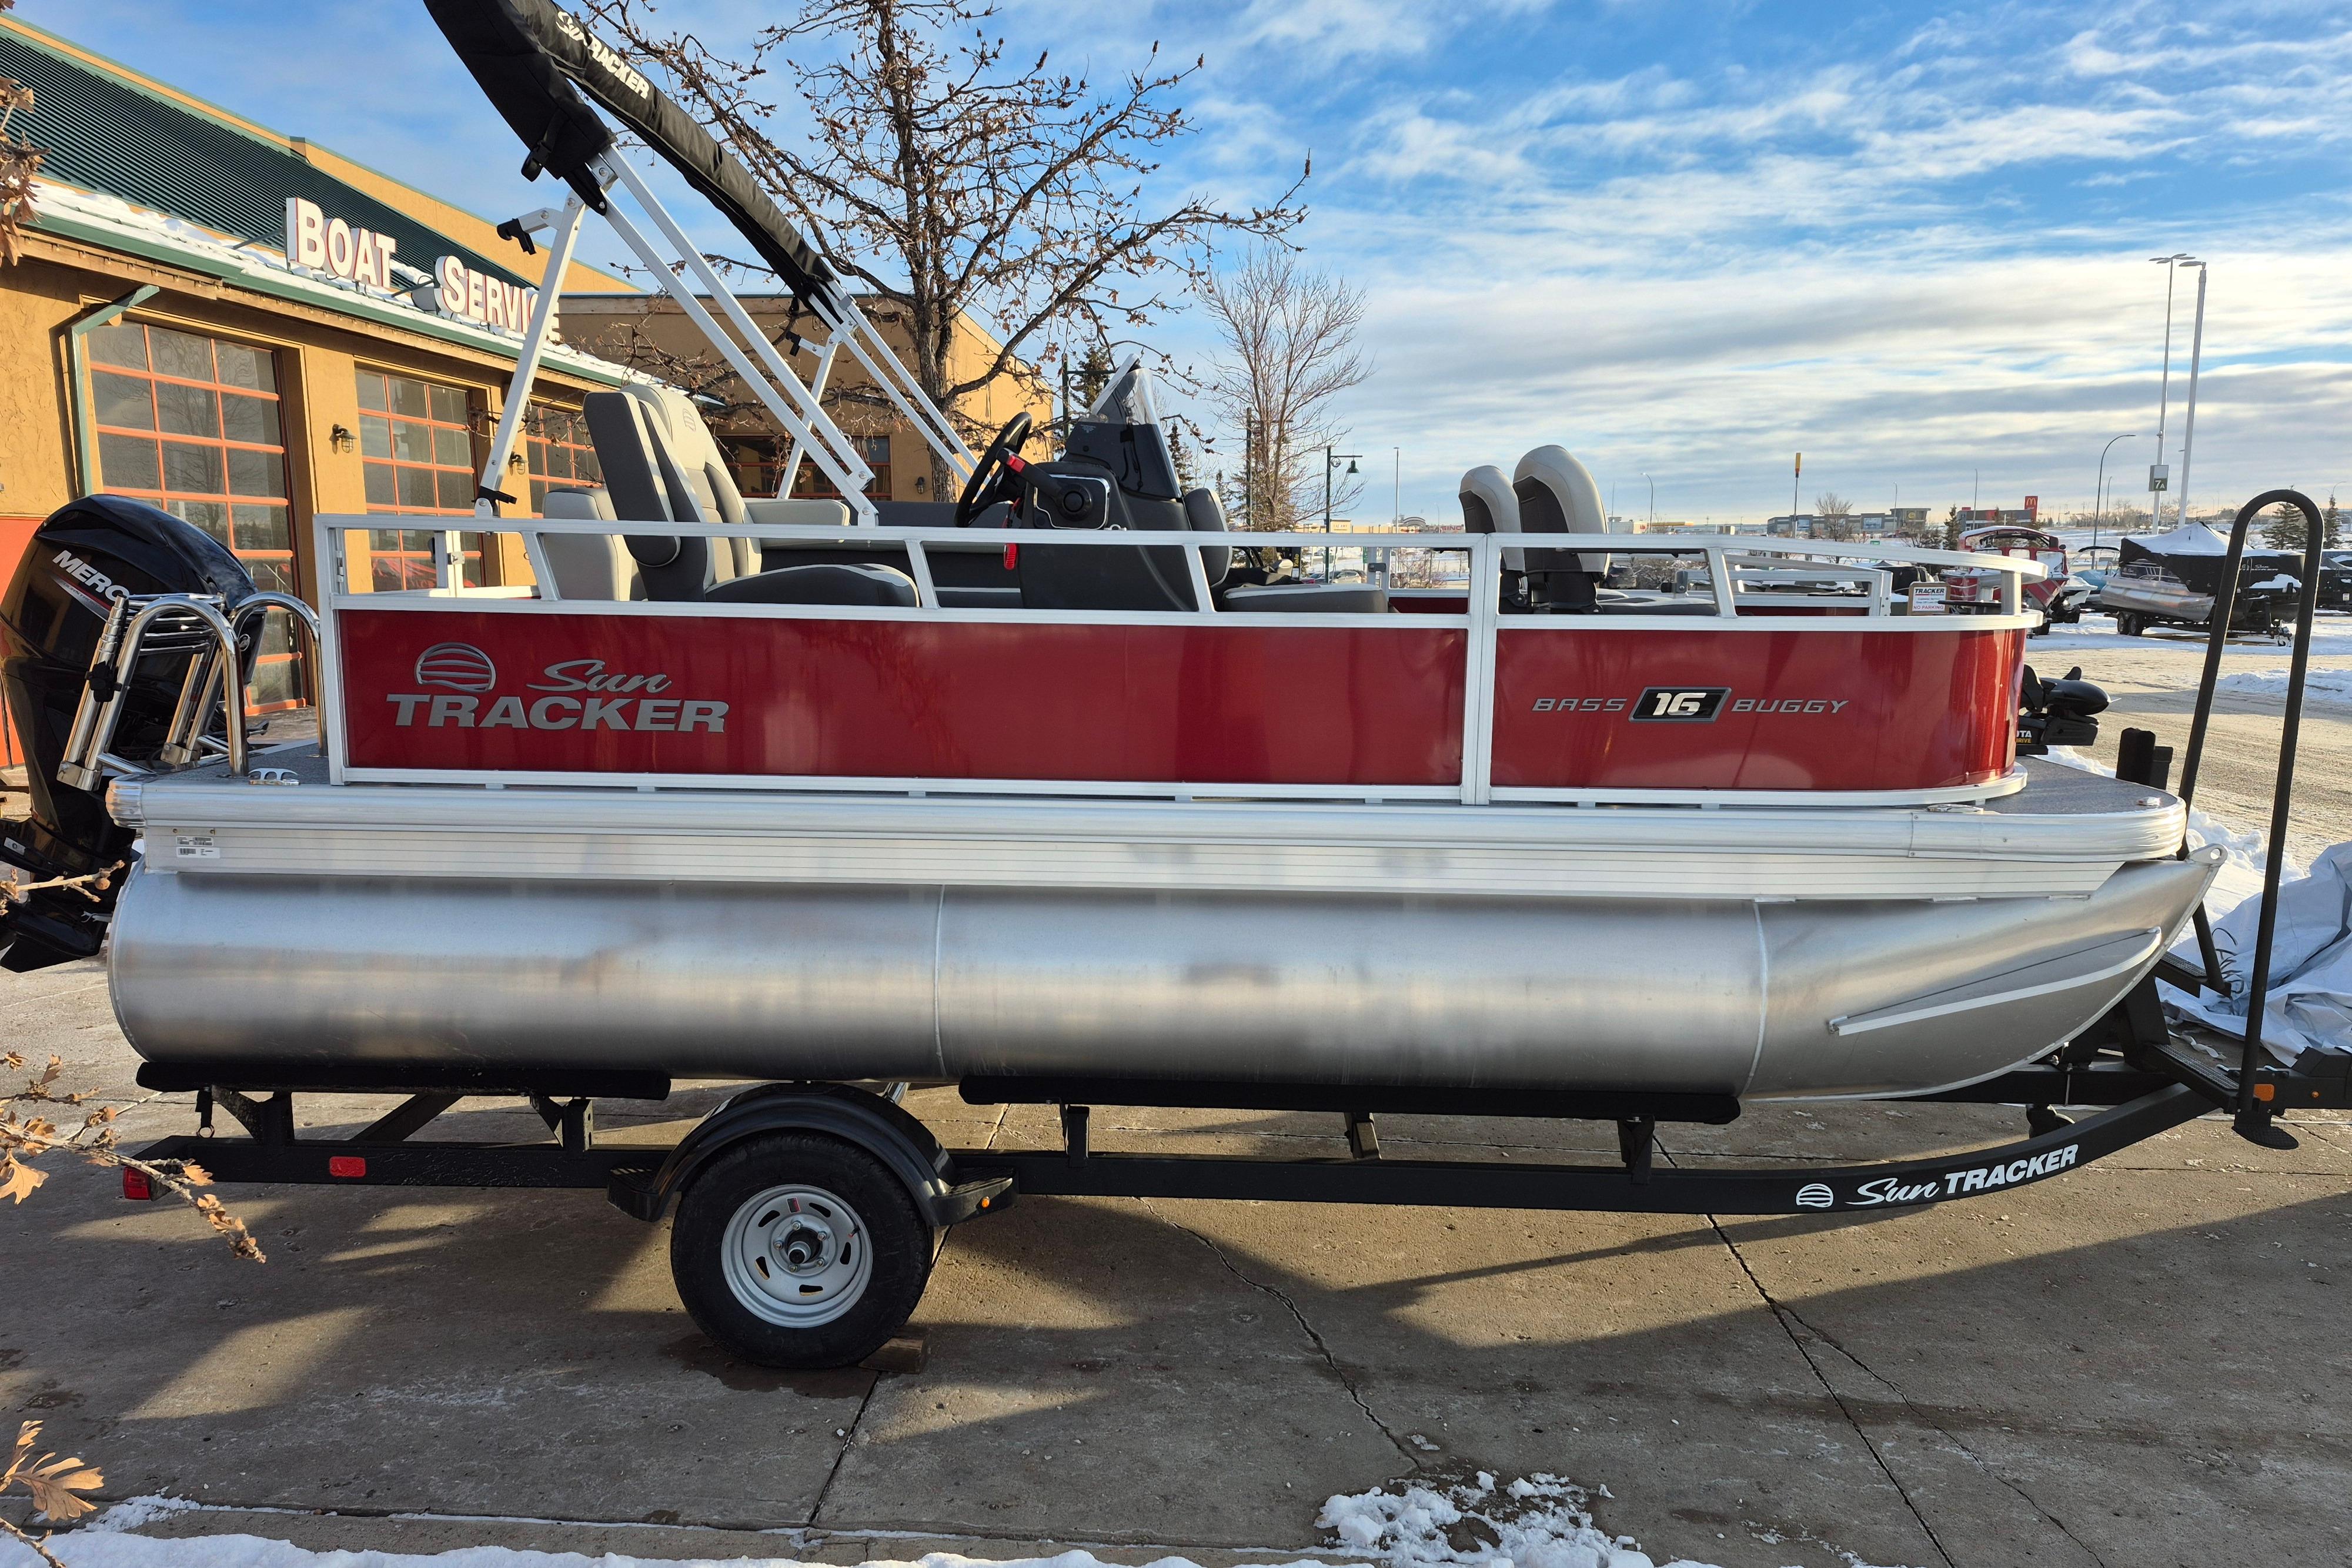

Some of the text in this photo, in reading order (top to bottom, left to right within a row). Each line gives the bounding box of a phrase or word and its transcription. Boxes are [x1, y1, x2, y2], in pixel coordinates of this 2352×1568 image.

[588, 33, 650, 100] RACKER
[295, 197, 396, 289] BOAT
[2154, 480, 2165, 489] 7A
[527, 659, 672, 694] Sun
[386, 694, 729, 733] TRACKER
[1531, 692, 1849, 716] BASS 16 BUGGY
[1845, 1144, 2079, 1206] Sun TRACKER
